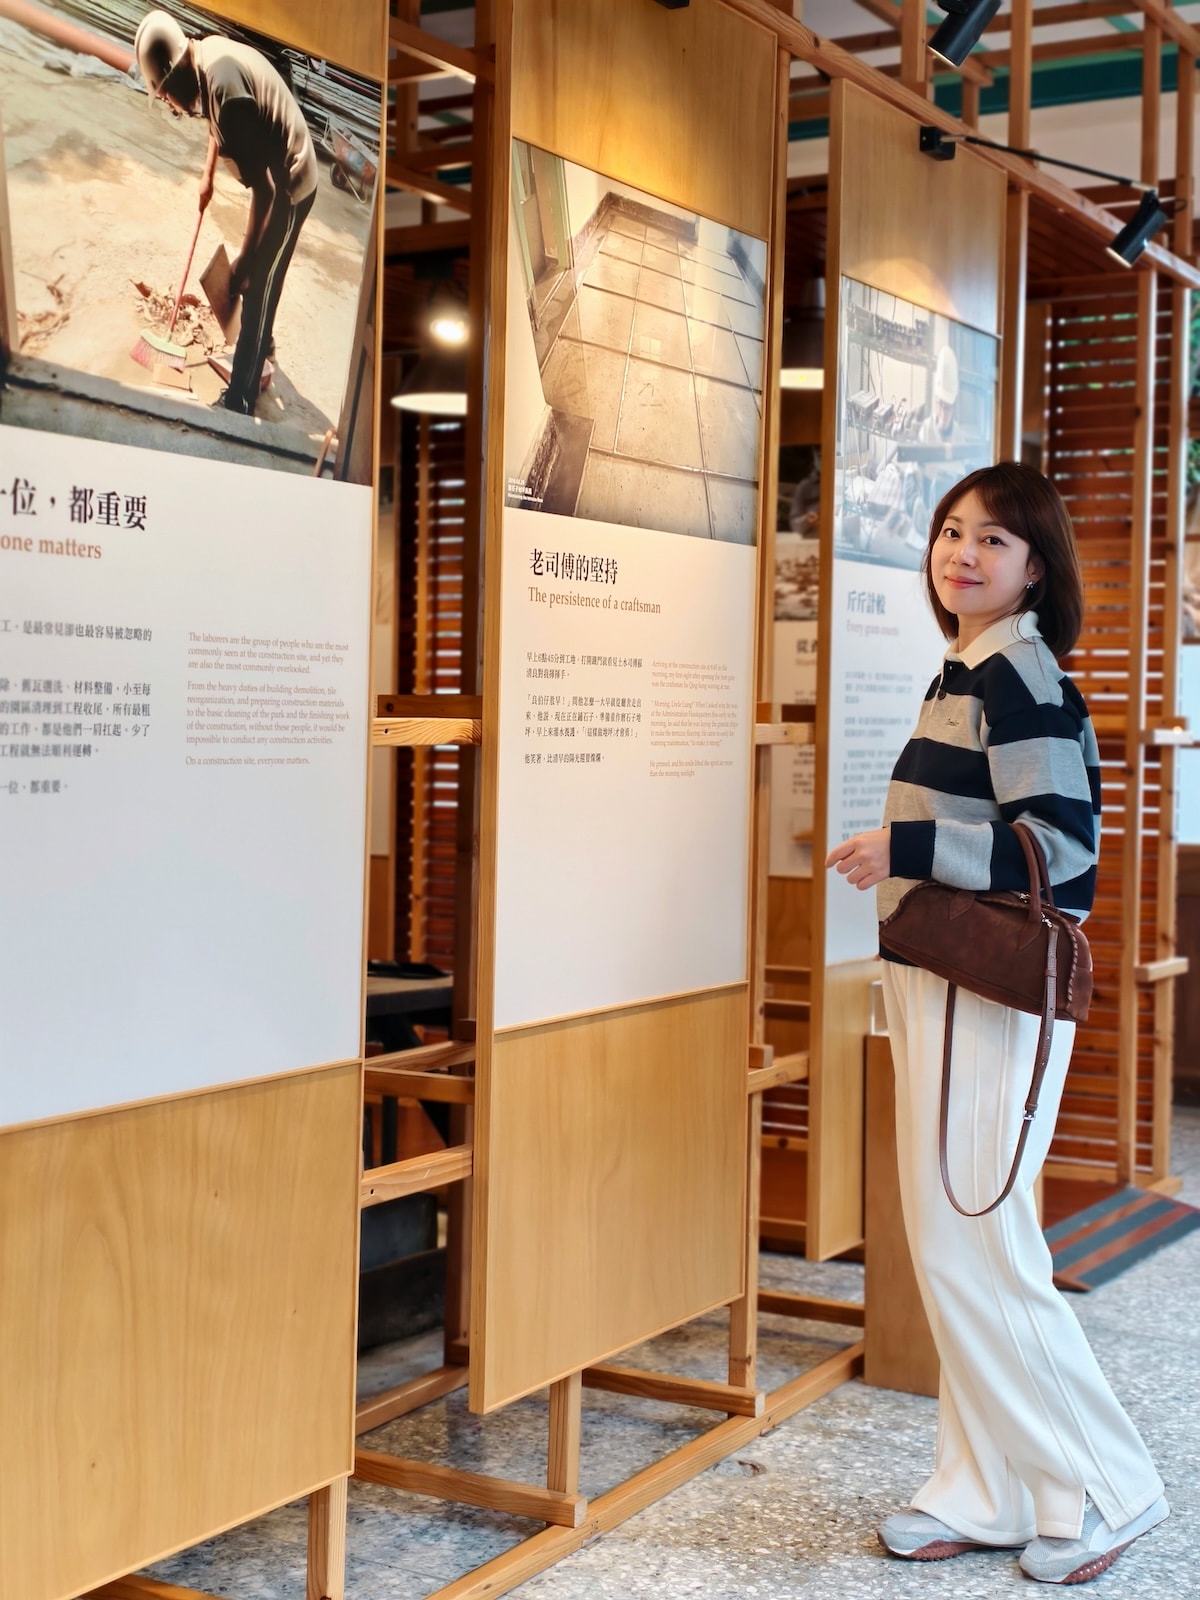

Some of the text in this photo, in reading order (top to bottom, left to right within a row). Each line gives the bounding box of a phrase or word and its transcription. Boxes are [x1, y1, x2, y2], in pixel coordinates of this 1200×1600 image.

[0, 477, 147, 531] 位，都重要
[38, 536, 102, 560] matters
[529, 548, 618, 585] 老司傅的堅持
[528, 586, 661, 614] The persistence of a craftsman
